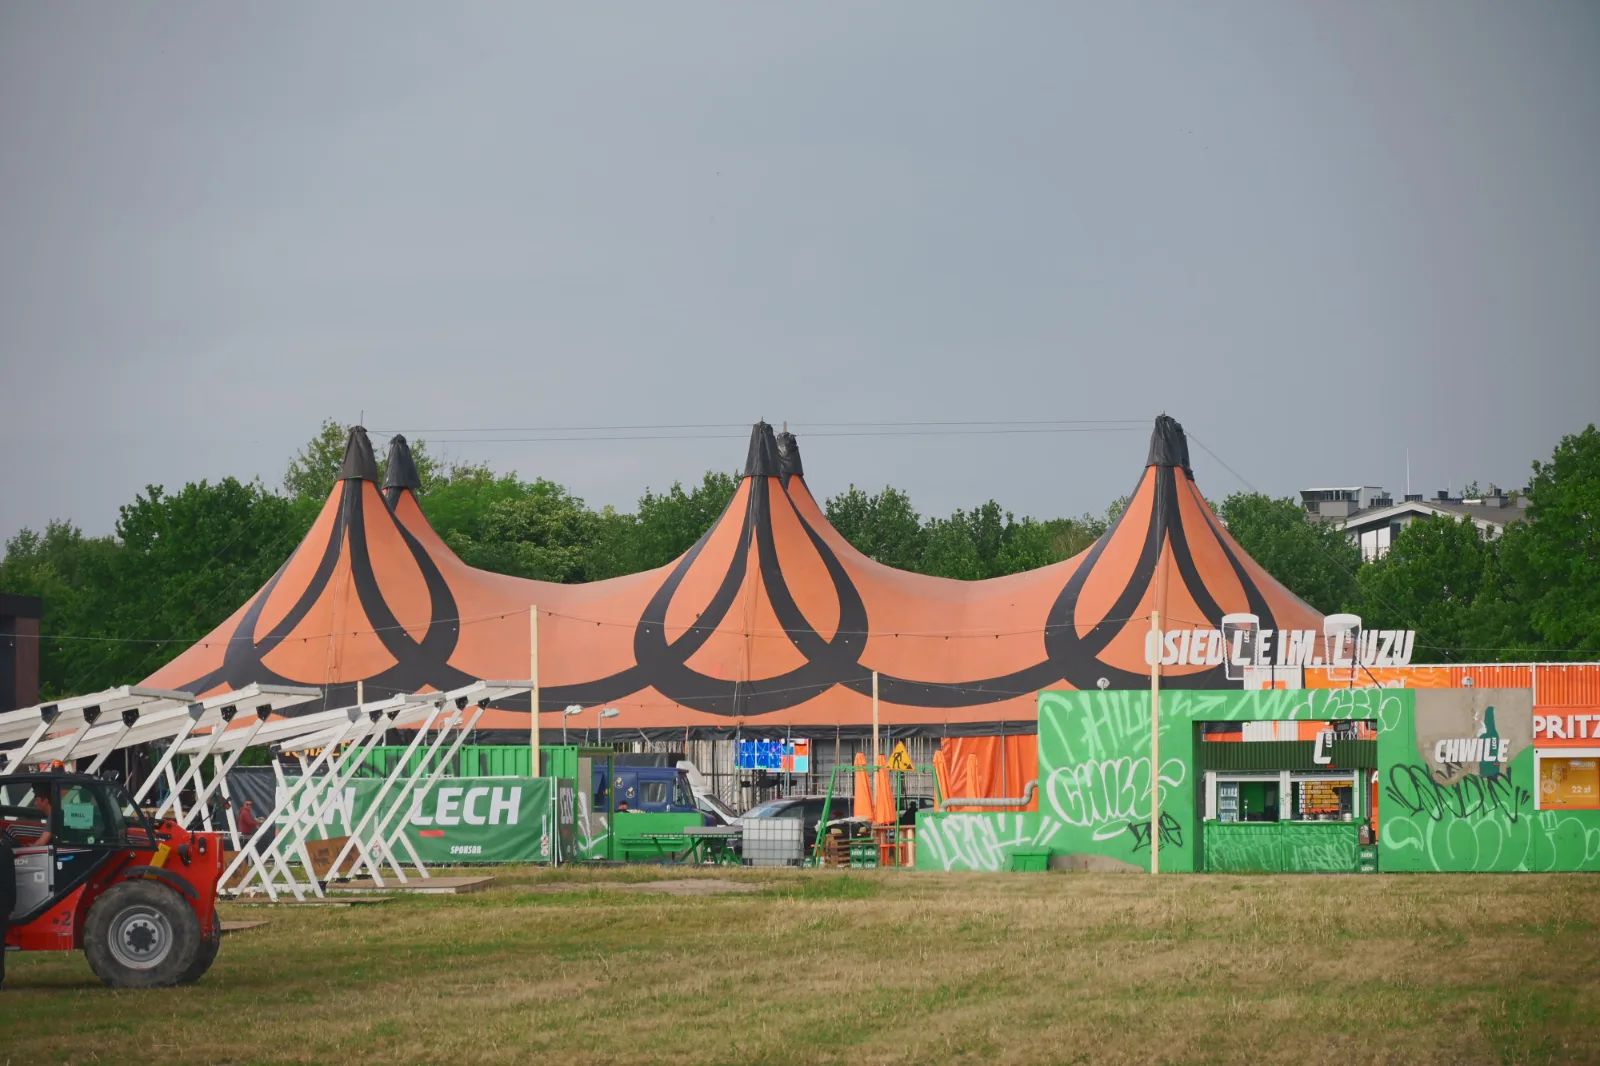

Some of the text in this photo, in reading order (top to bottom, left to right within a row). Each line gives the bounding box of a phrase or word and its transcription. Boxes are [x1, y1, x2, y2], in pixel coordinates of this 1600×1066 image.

[1145, 629, 1416, 667] OSIEDLE IM. LUZU
[1435, 738, 1510, 763] CHWILE
[410, 786, 522, 826] LECH
